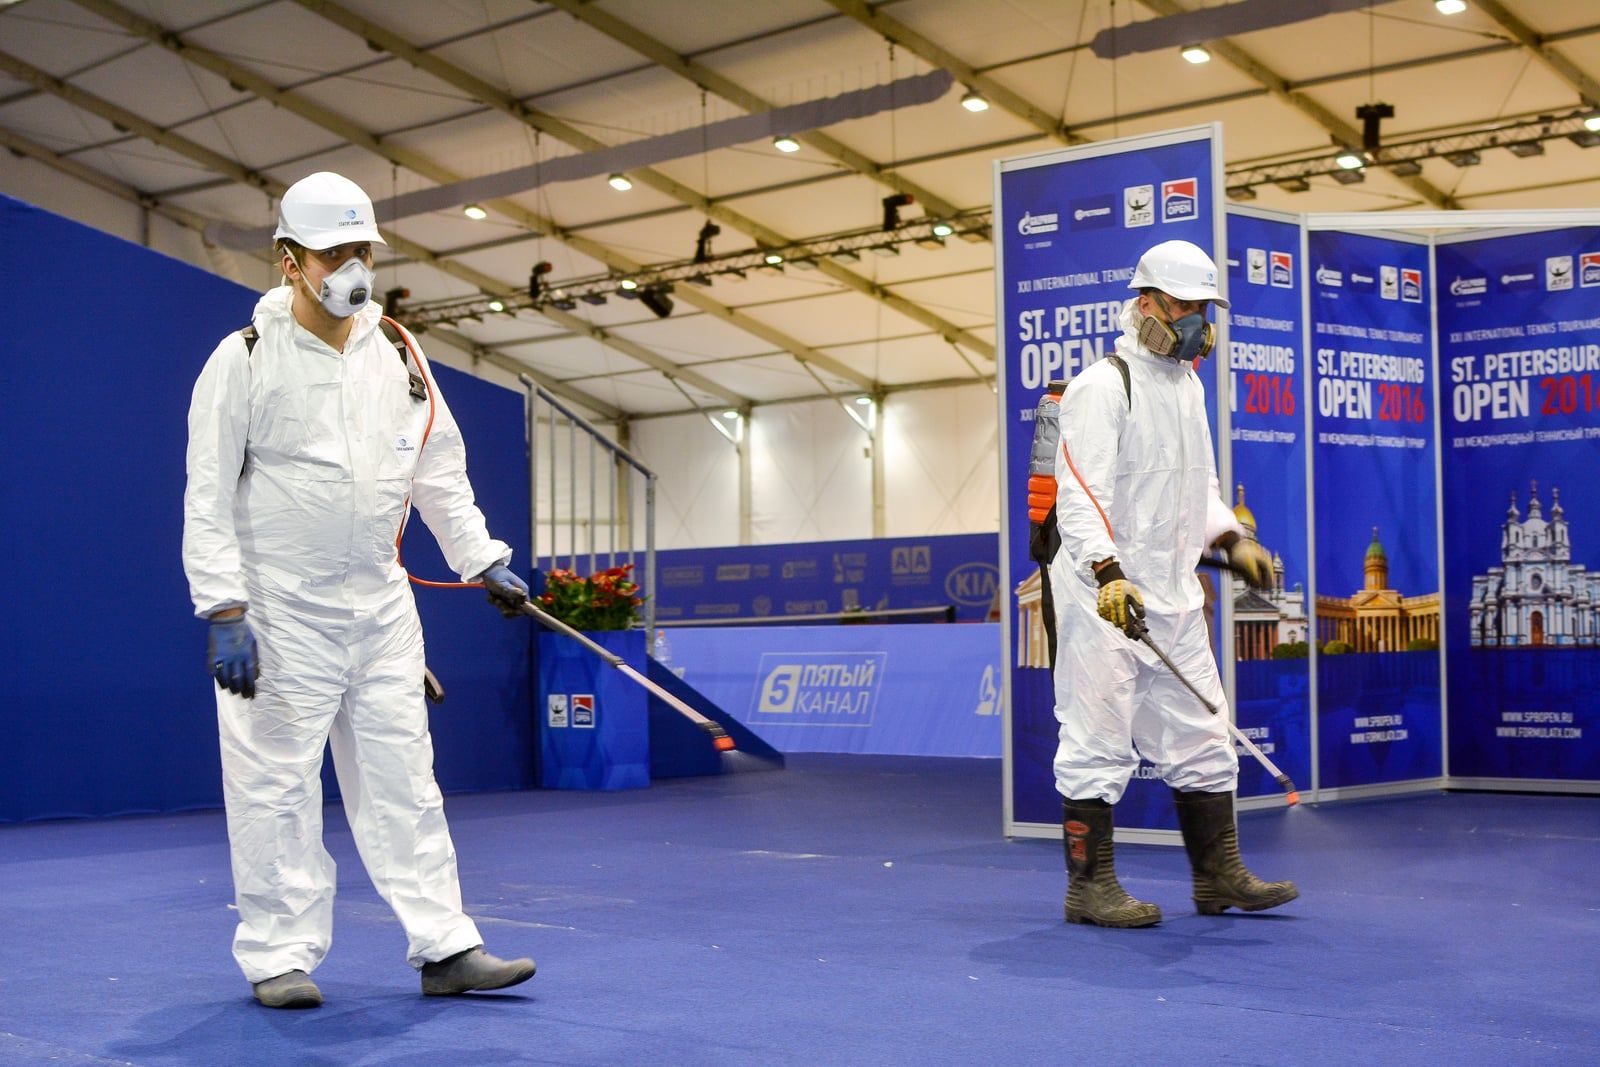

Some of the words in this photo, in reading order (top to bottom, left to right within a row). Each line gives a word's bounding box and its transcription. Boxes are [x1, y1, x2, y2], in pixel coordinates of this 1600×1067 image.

[1129, 211, 1151, 222] ATP
[1017, 280, 1032, 293] XXI
[1032, 271, 1101, 291] INTERNATIONAL
[1102, 267, 1135, 282] TENNIS
[1019, 309, 1051, 341] ST.
[1055, 300, 1123, 338] PETER
[1463, 325, 1525, 342] INTERNATIONAL
[1526, 322, 1556, 335] TENNIS
[1230, 341, 1295, 374] ERSBURG
[1317, 348, 1339, 376] ST.
[1340, 351, 1425, 384] PETERSBURG
[1451, 355, 1481, 383] ST.
[1484, 344, 1600, 380] PETERSBUR
[1243, 372, 1296, 416] 2016
[1318, 377, 1372, 420] OPEN
[1377, 382, 1426, 424] 2016
[1453, 378, 1530, 423] OPEN
[956, 572, 996, 596] KIA
[802, 659, 876, 688] ПЯТЫЙ
[796, 691, 870, 714] КАНАЛ
